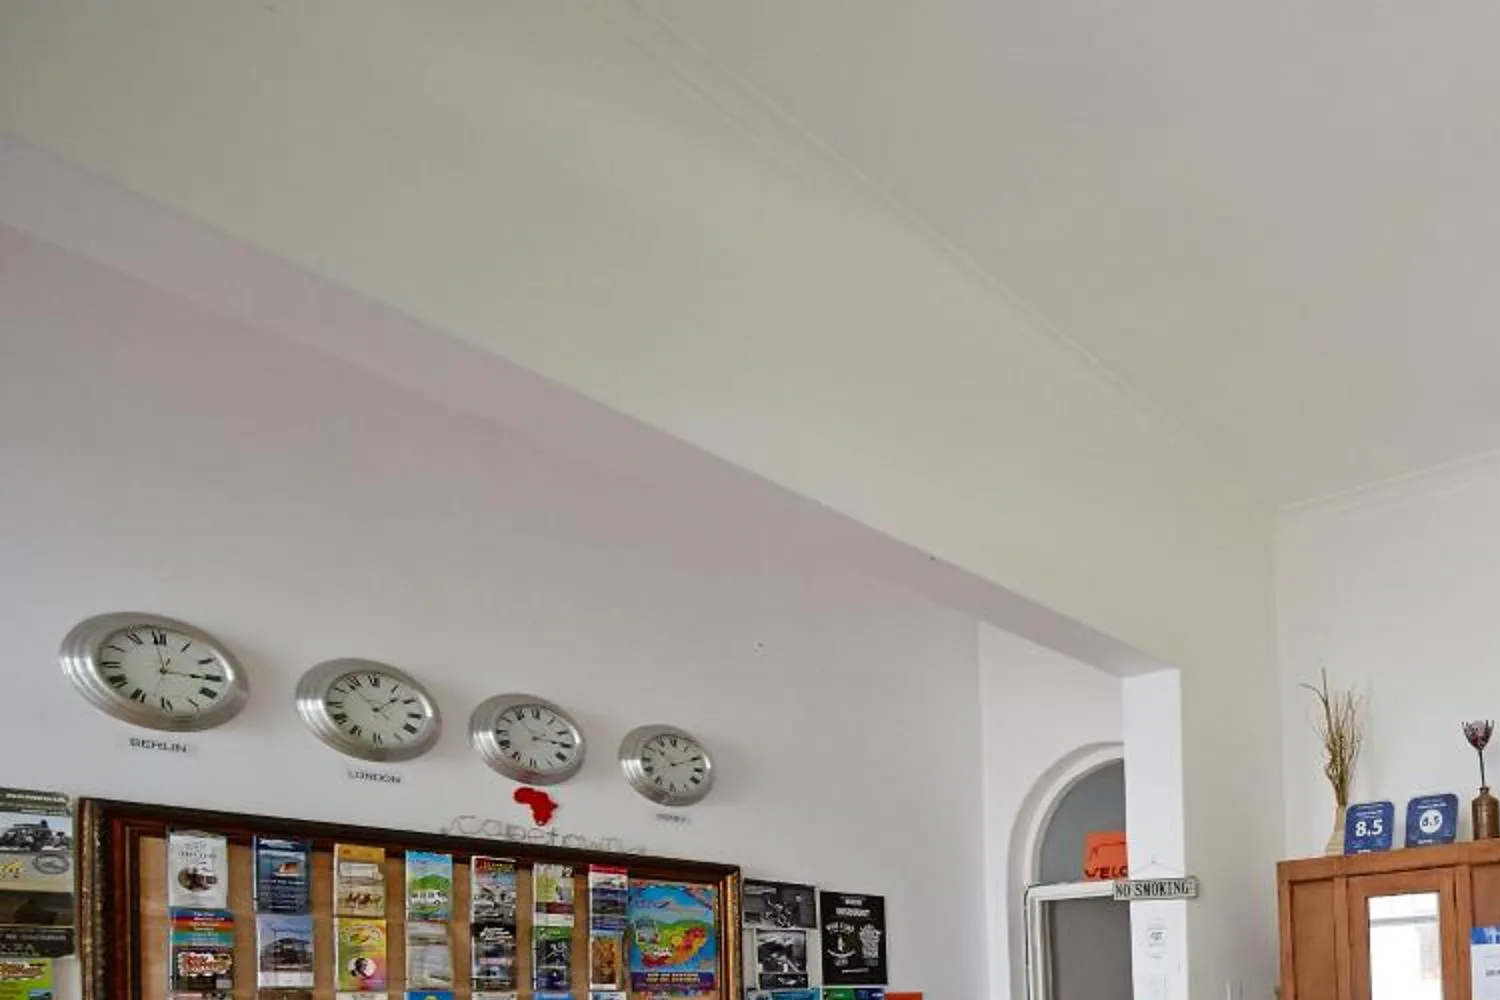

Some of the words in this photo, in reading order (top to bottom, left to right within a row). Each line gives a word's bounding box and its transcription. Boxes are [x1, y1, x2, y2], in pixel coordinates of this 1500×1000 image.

[1355, 818, 1383, 837] 8.5
[1115, 885, 1131, 897] NO
[1135, 880, 1189, 897] SMOKING
